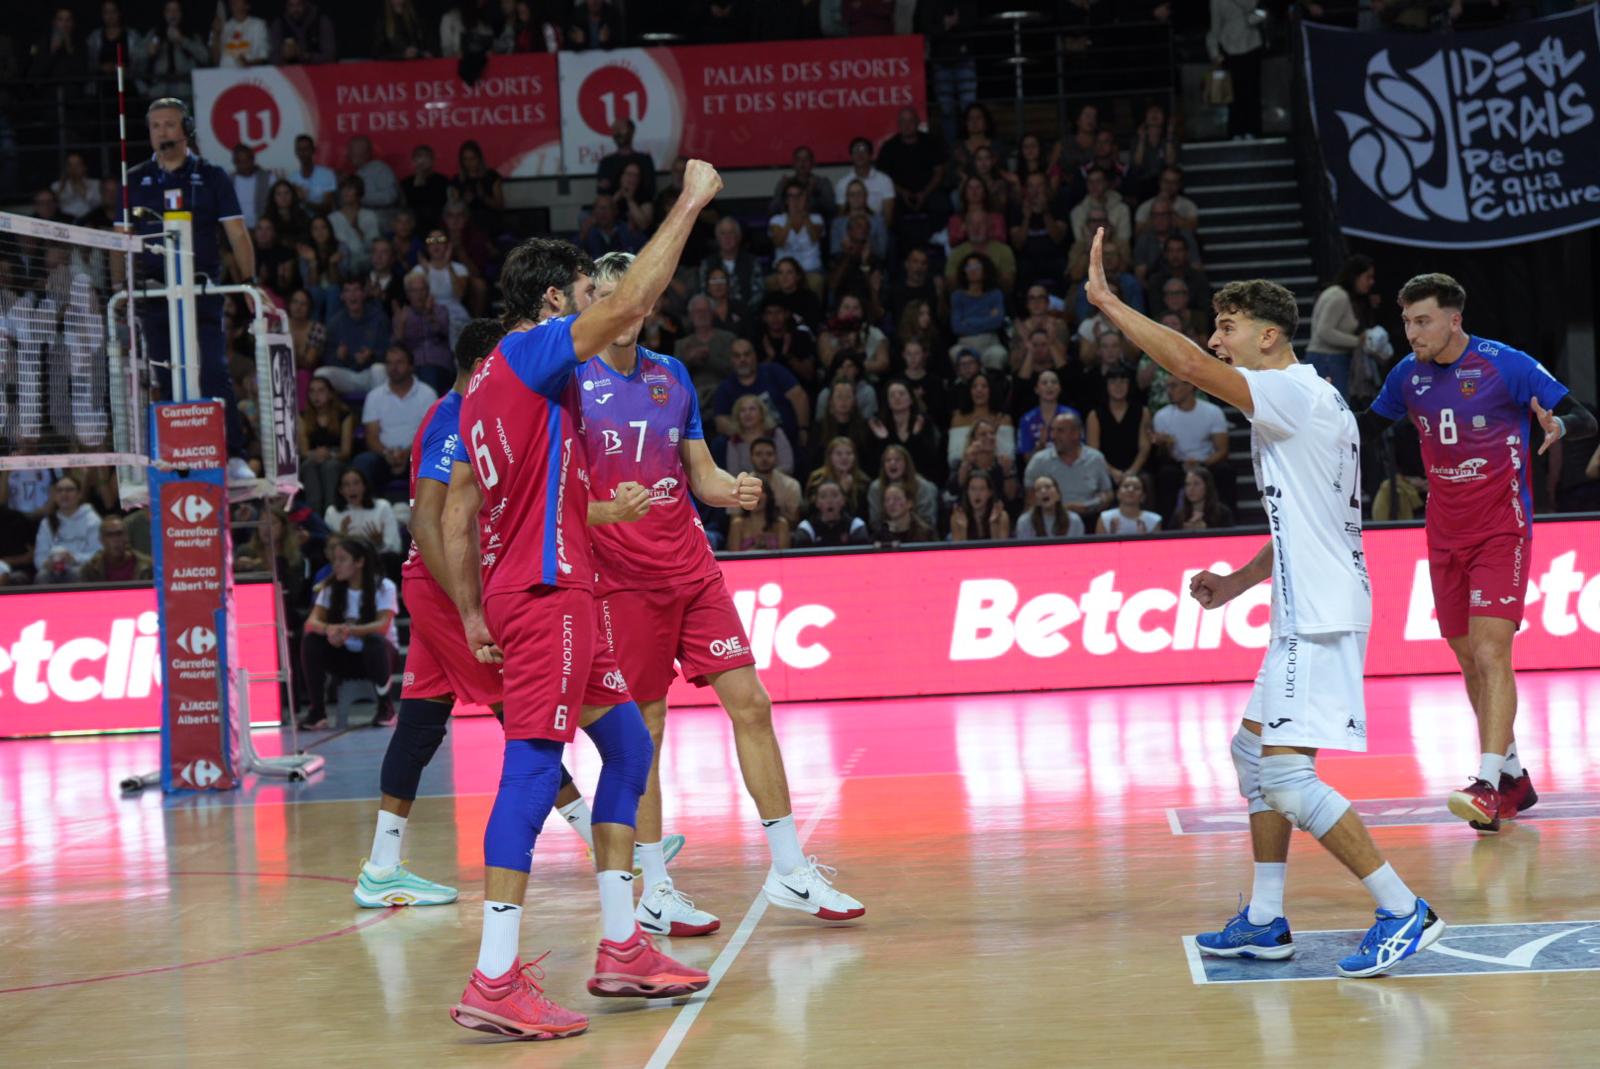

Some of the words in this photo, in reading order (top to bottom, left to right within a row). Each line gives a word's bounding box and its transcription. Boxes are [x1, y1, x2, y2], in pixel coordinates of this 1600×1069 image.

[704, 64, 774, 86] PALAIS
[782, 61, 823, 82] DES
[828, 57, 910, 80] SPORTS
[1450, 36, 1586, 97] IDEAL
[337, 83, 406, 104] PALAIS
[415, 80, 455, 100] DES
[461, 75, 543, 98] SPORTS
[704, 95, 727, 115] ET
[736, 91, 776, 113] DES
[783, 85, 913, 111] SPECTACLES
[337, 113, 361, 133] ET
[369, 110, 409, 131] DES
[416, 103, 546, 129] SPECTACLES
[1457, 82, 1594, 147] FRAIS
[1462, 147, 1564, 174] Pêche
[1471, 185, 1600, 221] Culture
[161, 405, 214, 418] Carrefour
[171, 417, 208, 428] market
[1439, 409, 1458, 444] 8
[173, 446, 216, 458] AJACCIO
[471, 420, 498, 490] 6
[629, 421, 647, 462] 7
[1510, 446, 1521, 470] AIR
[556, 438, 573, 525] CORSICA
[167, 526, 219, 537] Carrefour
[1268, 501, 1281, 532] AIR
[174, 538, 211, 548] market
[556, 527, 567, 562] AIR
[171, 581, 202, 591] Albert
[173, 567, 216, 578] AJACCIO
[602, 600, 615, 652] LUCCIONI
[949, 561, 1271, 661] Betclic
[0, 610, 162, 704] tcli
[562, 615, 573, 675] LUCCIONI
[172, 658, 216, 669] Carrefo
[1285, 638, 1298, 698] LUCCIONI
[177, 715, 210, 725] Albert
[179, 701, 218, 712] AJACCI
[554, 705, 568, 730] 6
